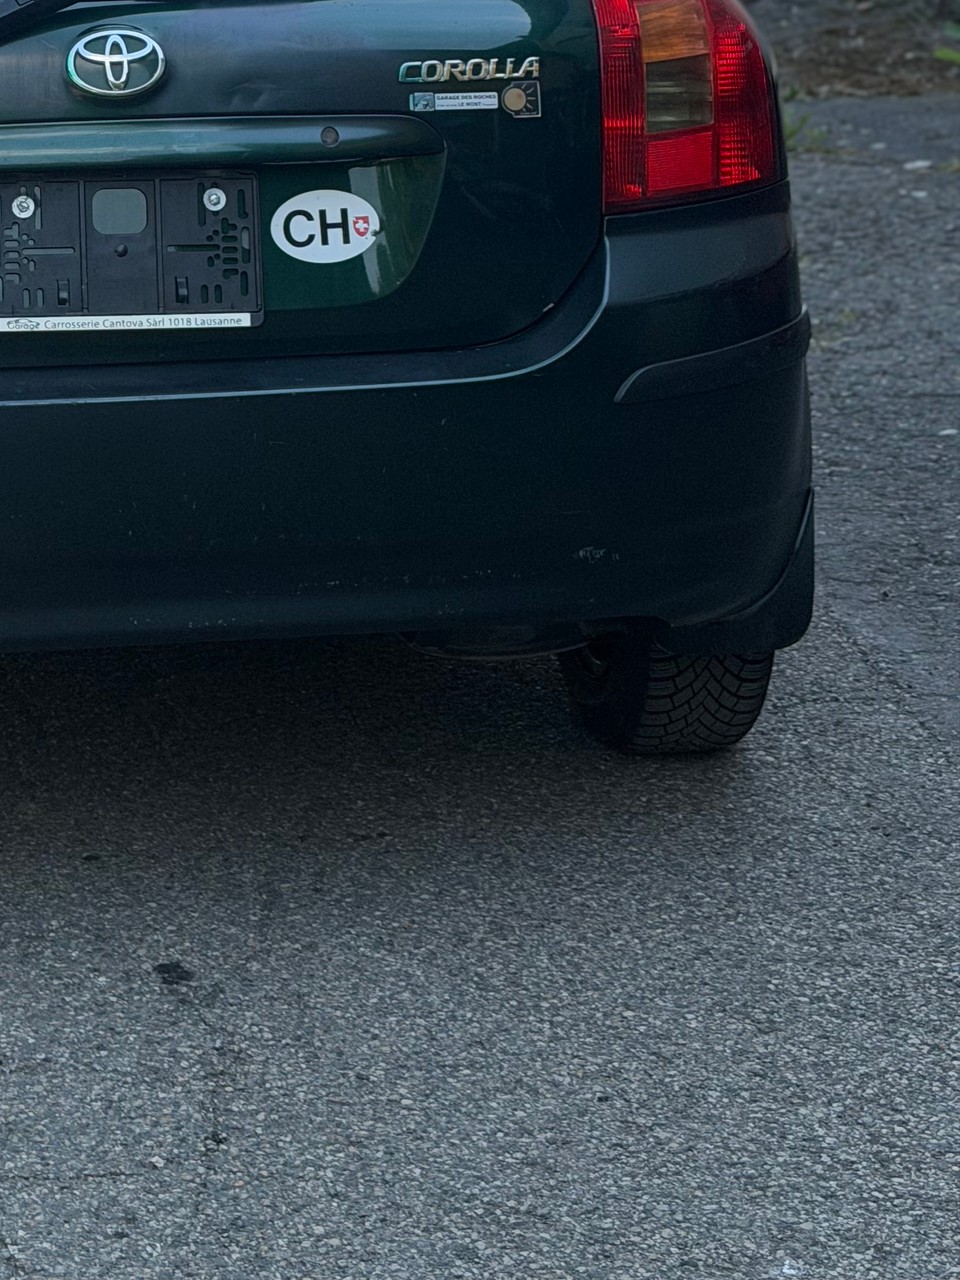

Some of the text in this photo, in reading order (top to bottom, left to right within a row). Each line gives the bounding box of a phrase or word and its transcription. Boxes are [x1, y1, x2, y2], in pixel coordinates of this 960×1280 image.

[398, 56, 540, 82] COROLLA
[283, 208, 351, 248] CH
[7, 320, 40, 330] Garage
[44, 319, 100, 329] Carrosserie
[102, 319, 144, 328] Cantova
[168, 317, 192, 327] 1018
[194, 317, 243, 326] Lausanne
